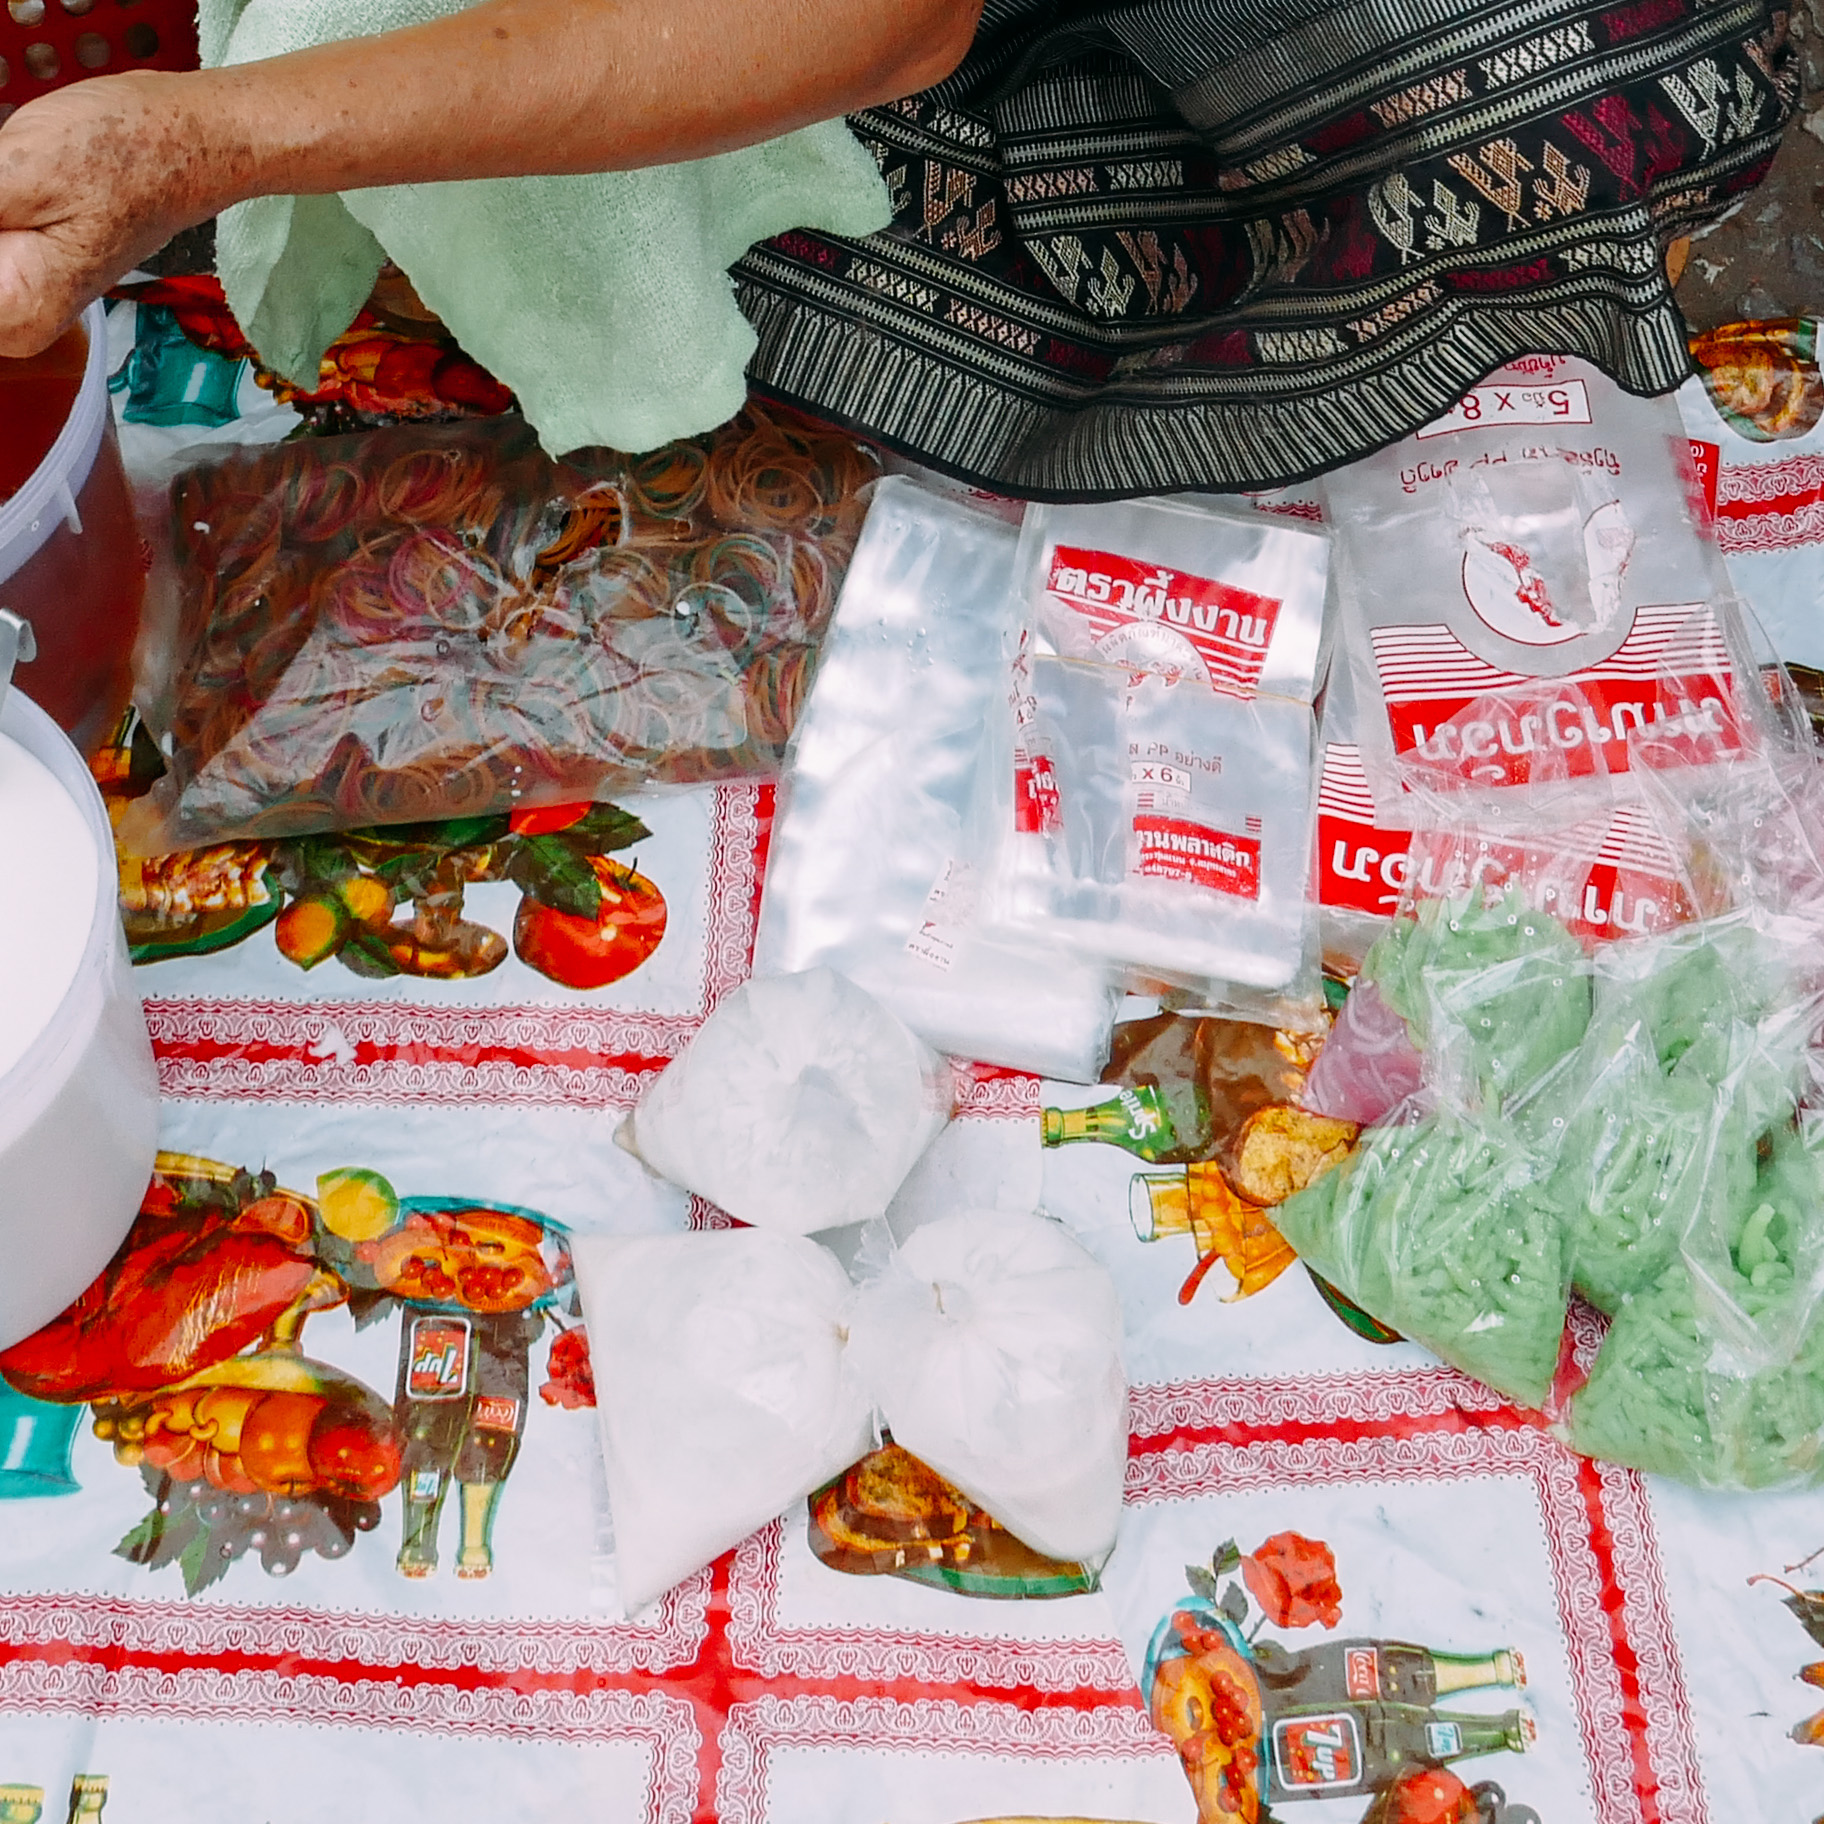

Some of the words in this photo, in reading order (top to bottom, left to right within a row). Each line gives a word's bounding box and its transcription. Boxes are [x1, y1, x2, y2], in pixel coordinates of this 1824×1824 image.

[1460, 393, 1482, 421] 8
[1548, 390, 1570, 415] 5
[1055, 567, 1268, 646] ตราผึ้งงาน
[1160, 766, 1173, 783] 6
[1119, 1088, 1158, 1140] Sprite
